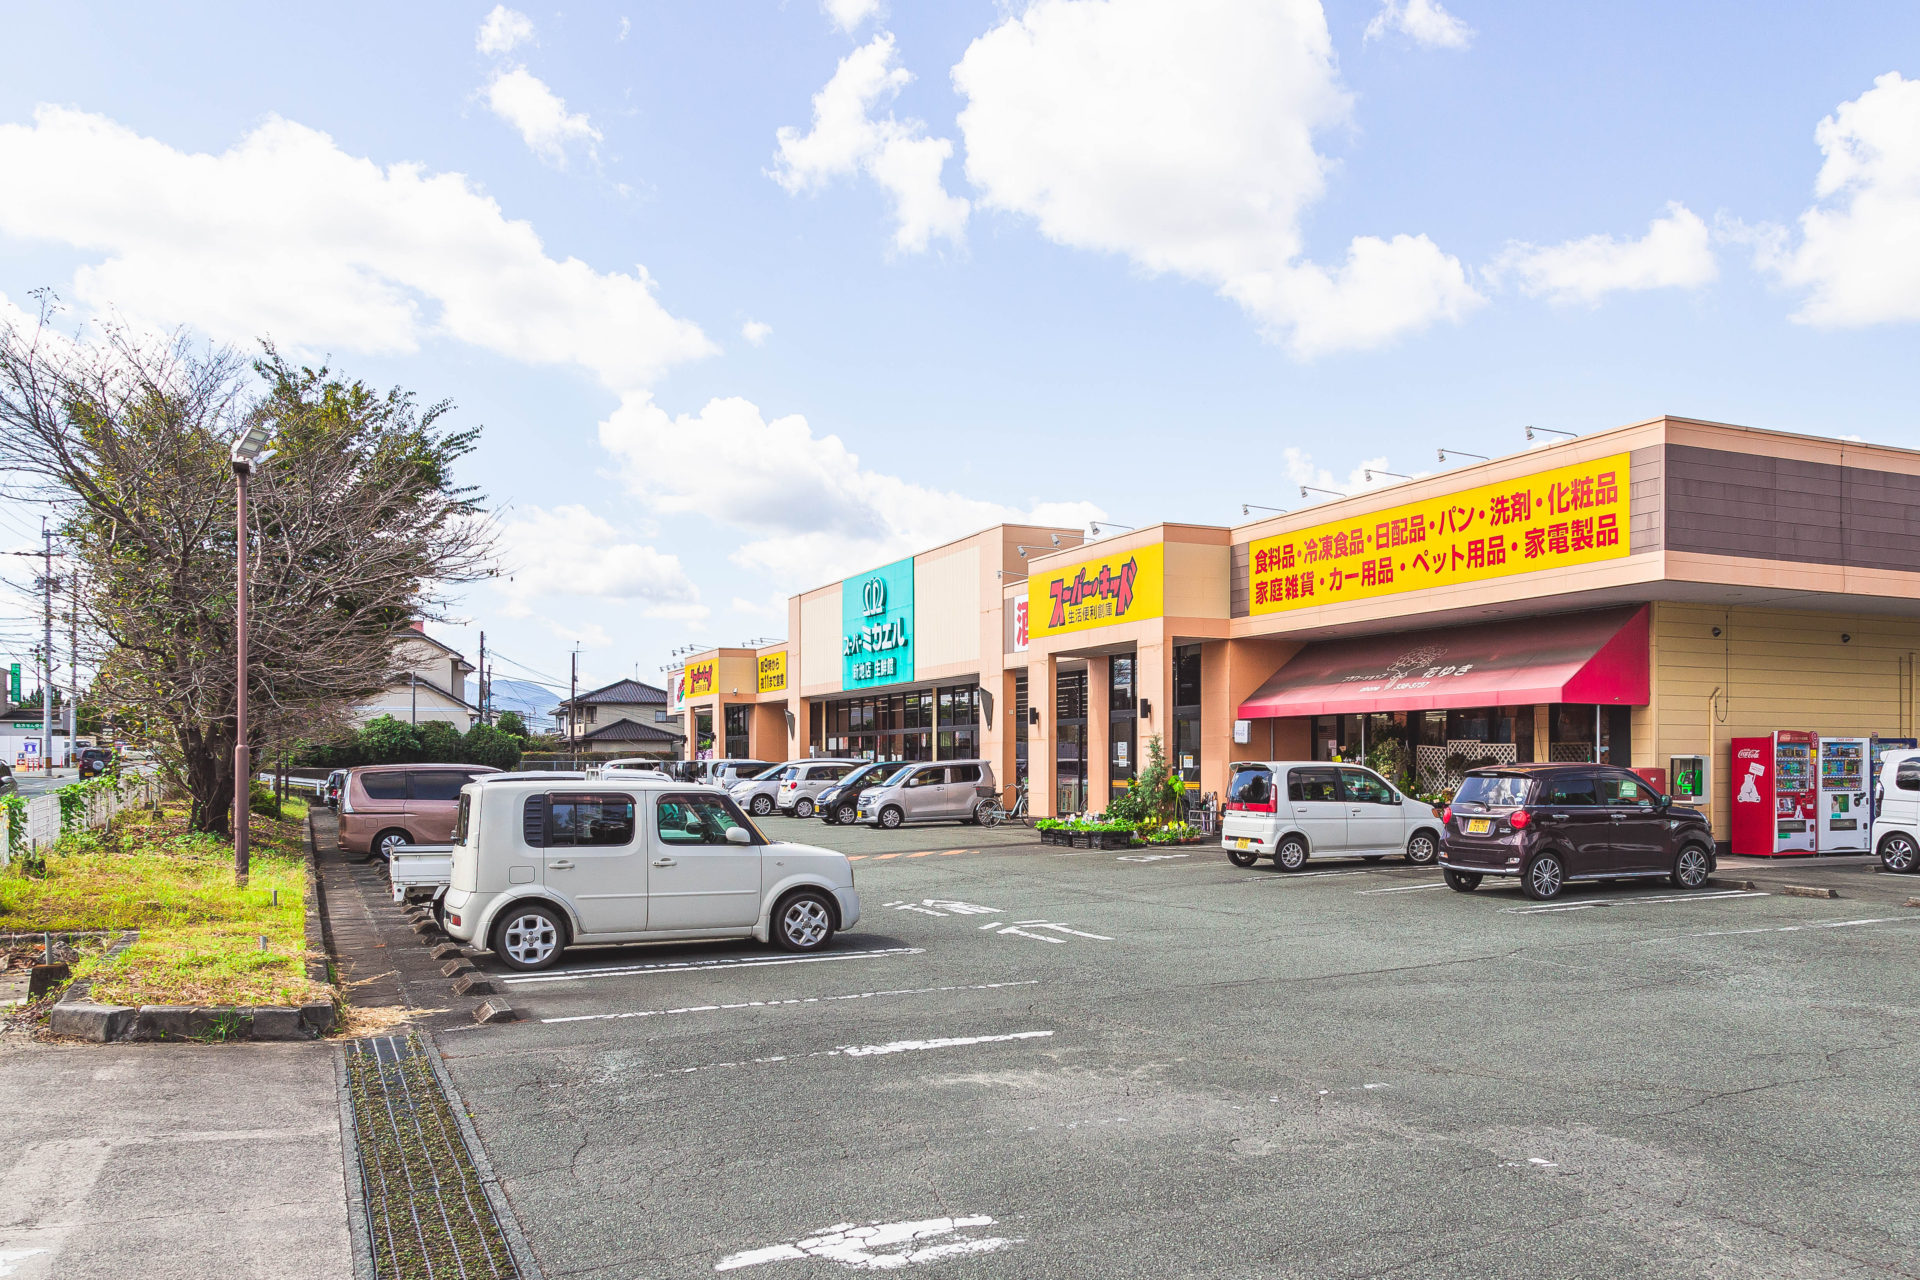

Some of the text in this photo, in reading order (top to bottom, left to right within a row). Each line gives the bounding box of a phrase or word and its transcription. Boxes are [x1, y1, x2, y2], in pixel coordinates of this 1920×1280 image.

[1255, 471, 1618, 575] 食料品・冷凍食品・日配品・パン・洗剤・化粧品
[1255, 513, 1619, 605] 家庭雑貨・カー用品・ペット用品・家電製品
